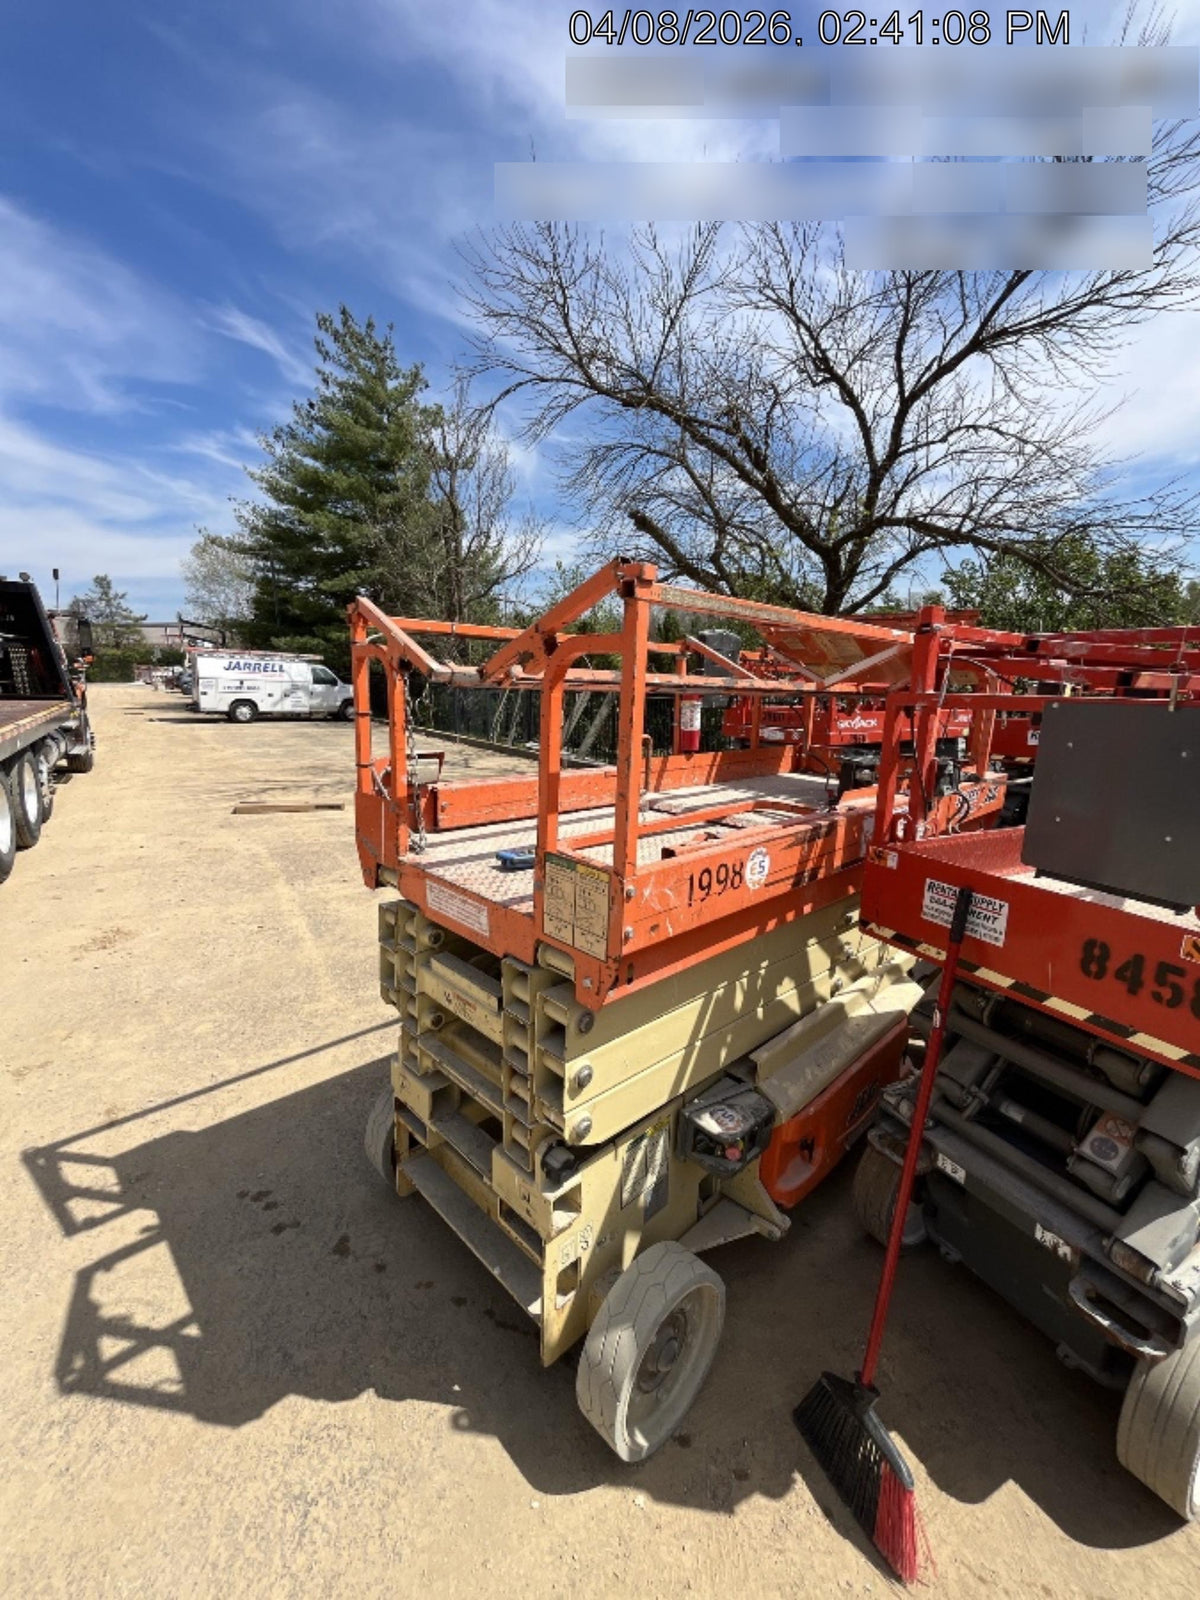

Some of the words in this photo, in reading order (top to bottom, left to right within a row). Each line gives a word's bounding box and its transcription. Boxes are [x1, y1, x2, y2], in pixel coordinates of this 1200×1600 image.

[223, 660, 285, 673] JARRELL
[687, 861, 744, 907] 1998
[927, 881, 959, 898] RENTA
[971, 896, 1006, 912] UPPLY
